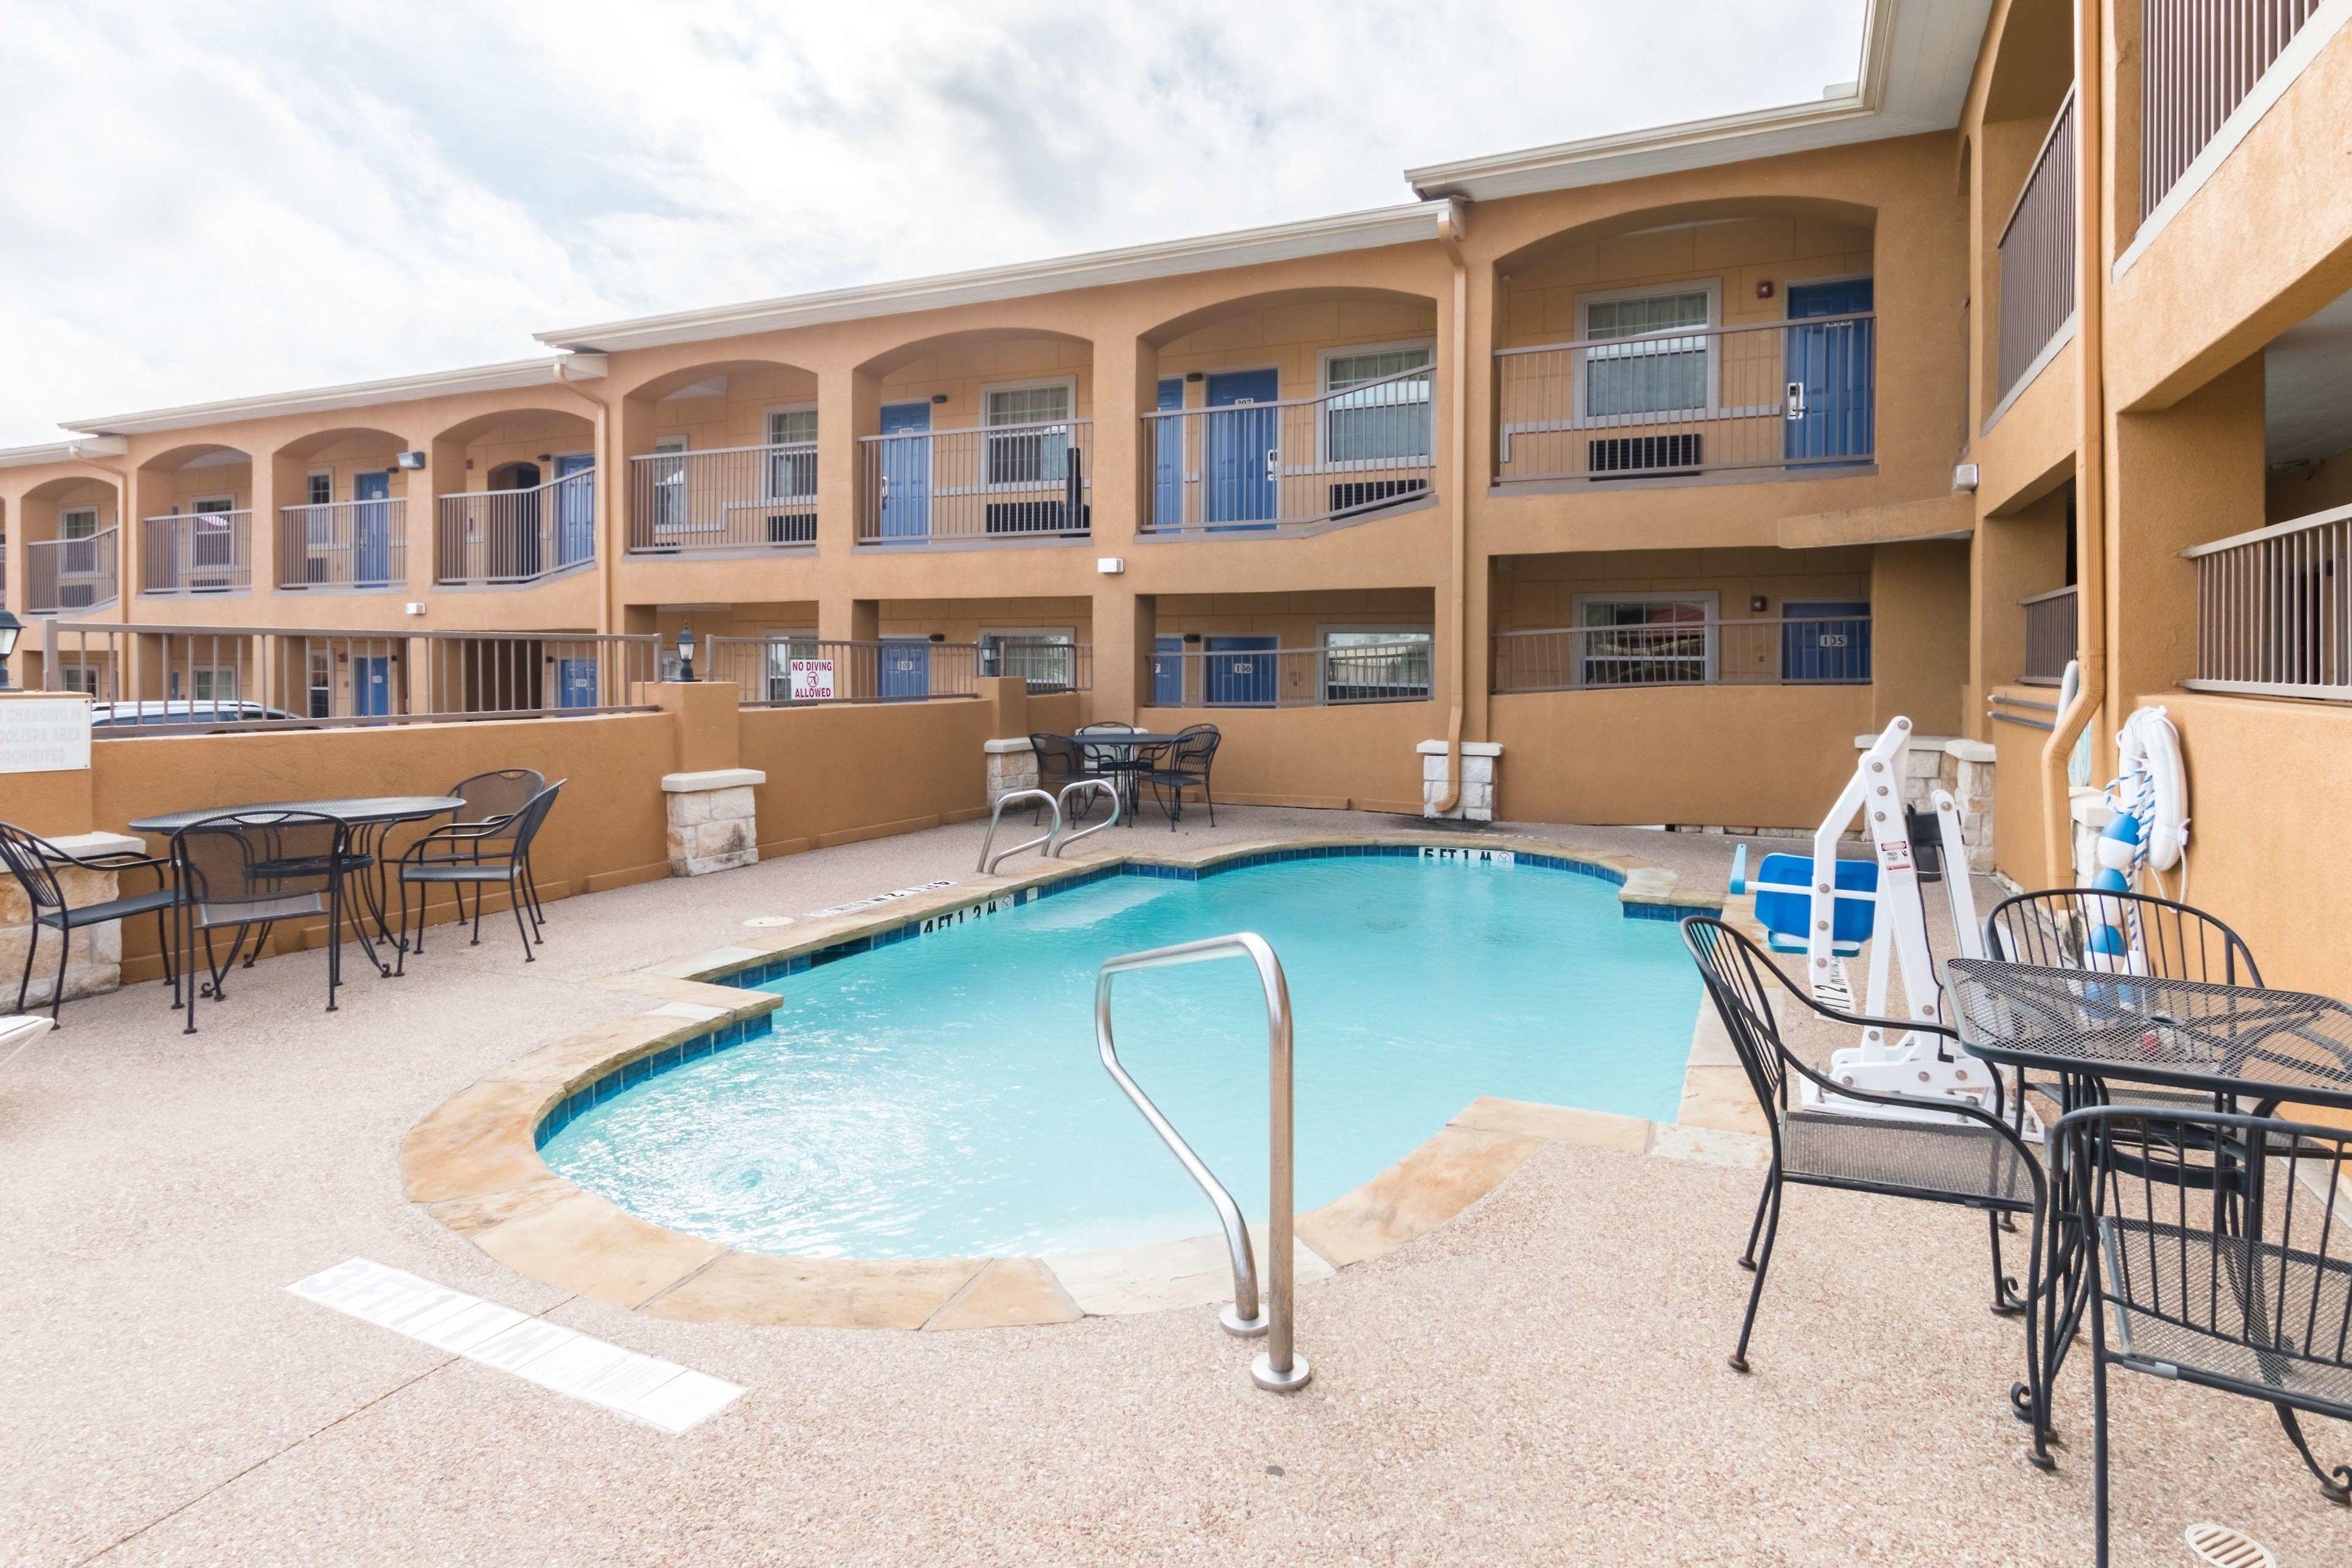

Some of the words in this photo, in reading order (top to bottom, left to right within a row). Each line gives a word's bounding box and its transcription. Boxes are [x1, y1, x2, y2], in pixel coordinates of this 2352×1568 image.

[792, 661, 804, 671] NO
[807, 661, 832, 671] DIVING
[795, 687, 831, 698] ALLOWED
[1440, 848, 1457, 859] FT
[923, 920, 934, 934] 4
[938, 913, 953, 930] FT
[958, 910, 963, 923] 1
[973, 905, 981, 919] 2
[987, 901, 997, 915] M
